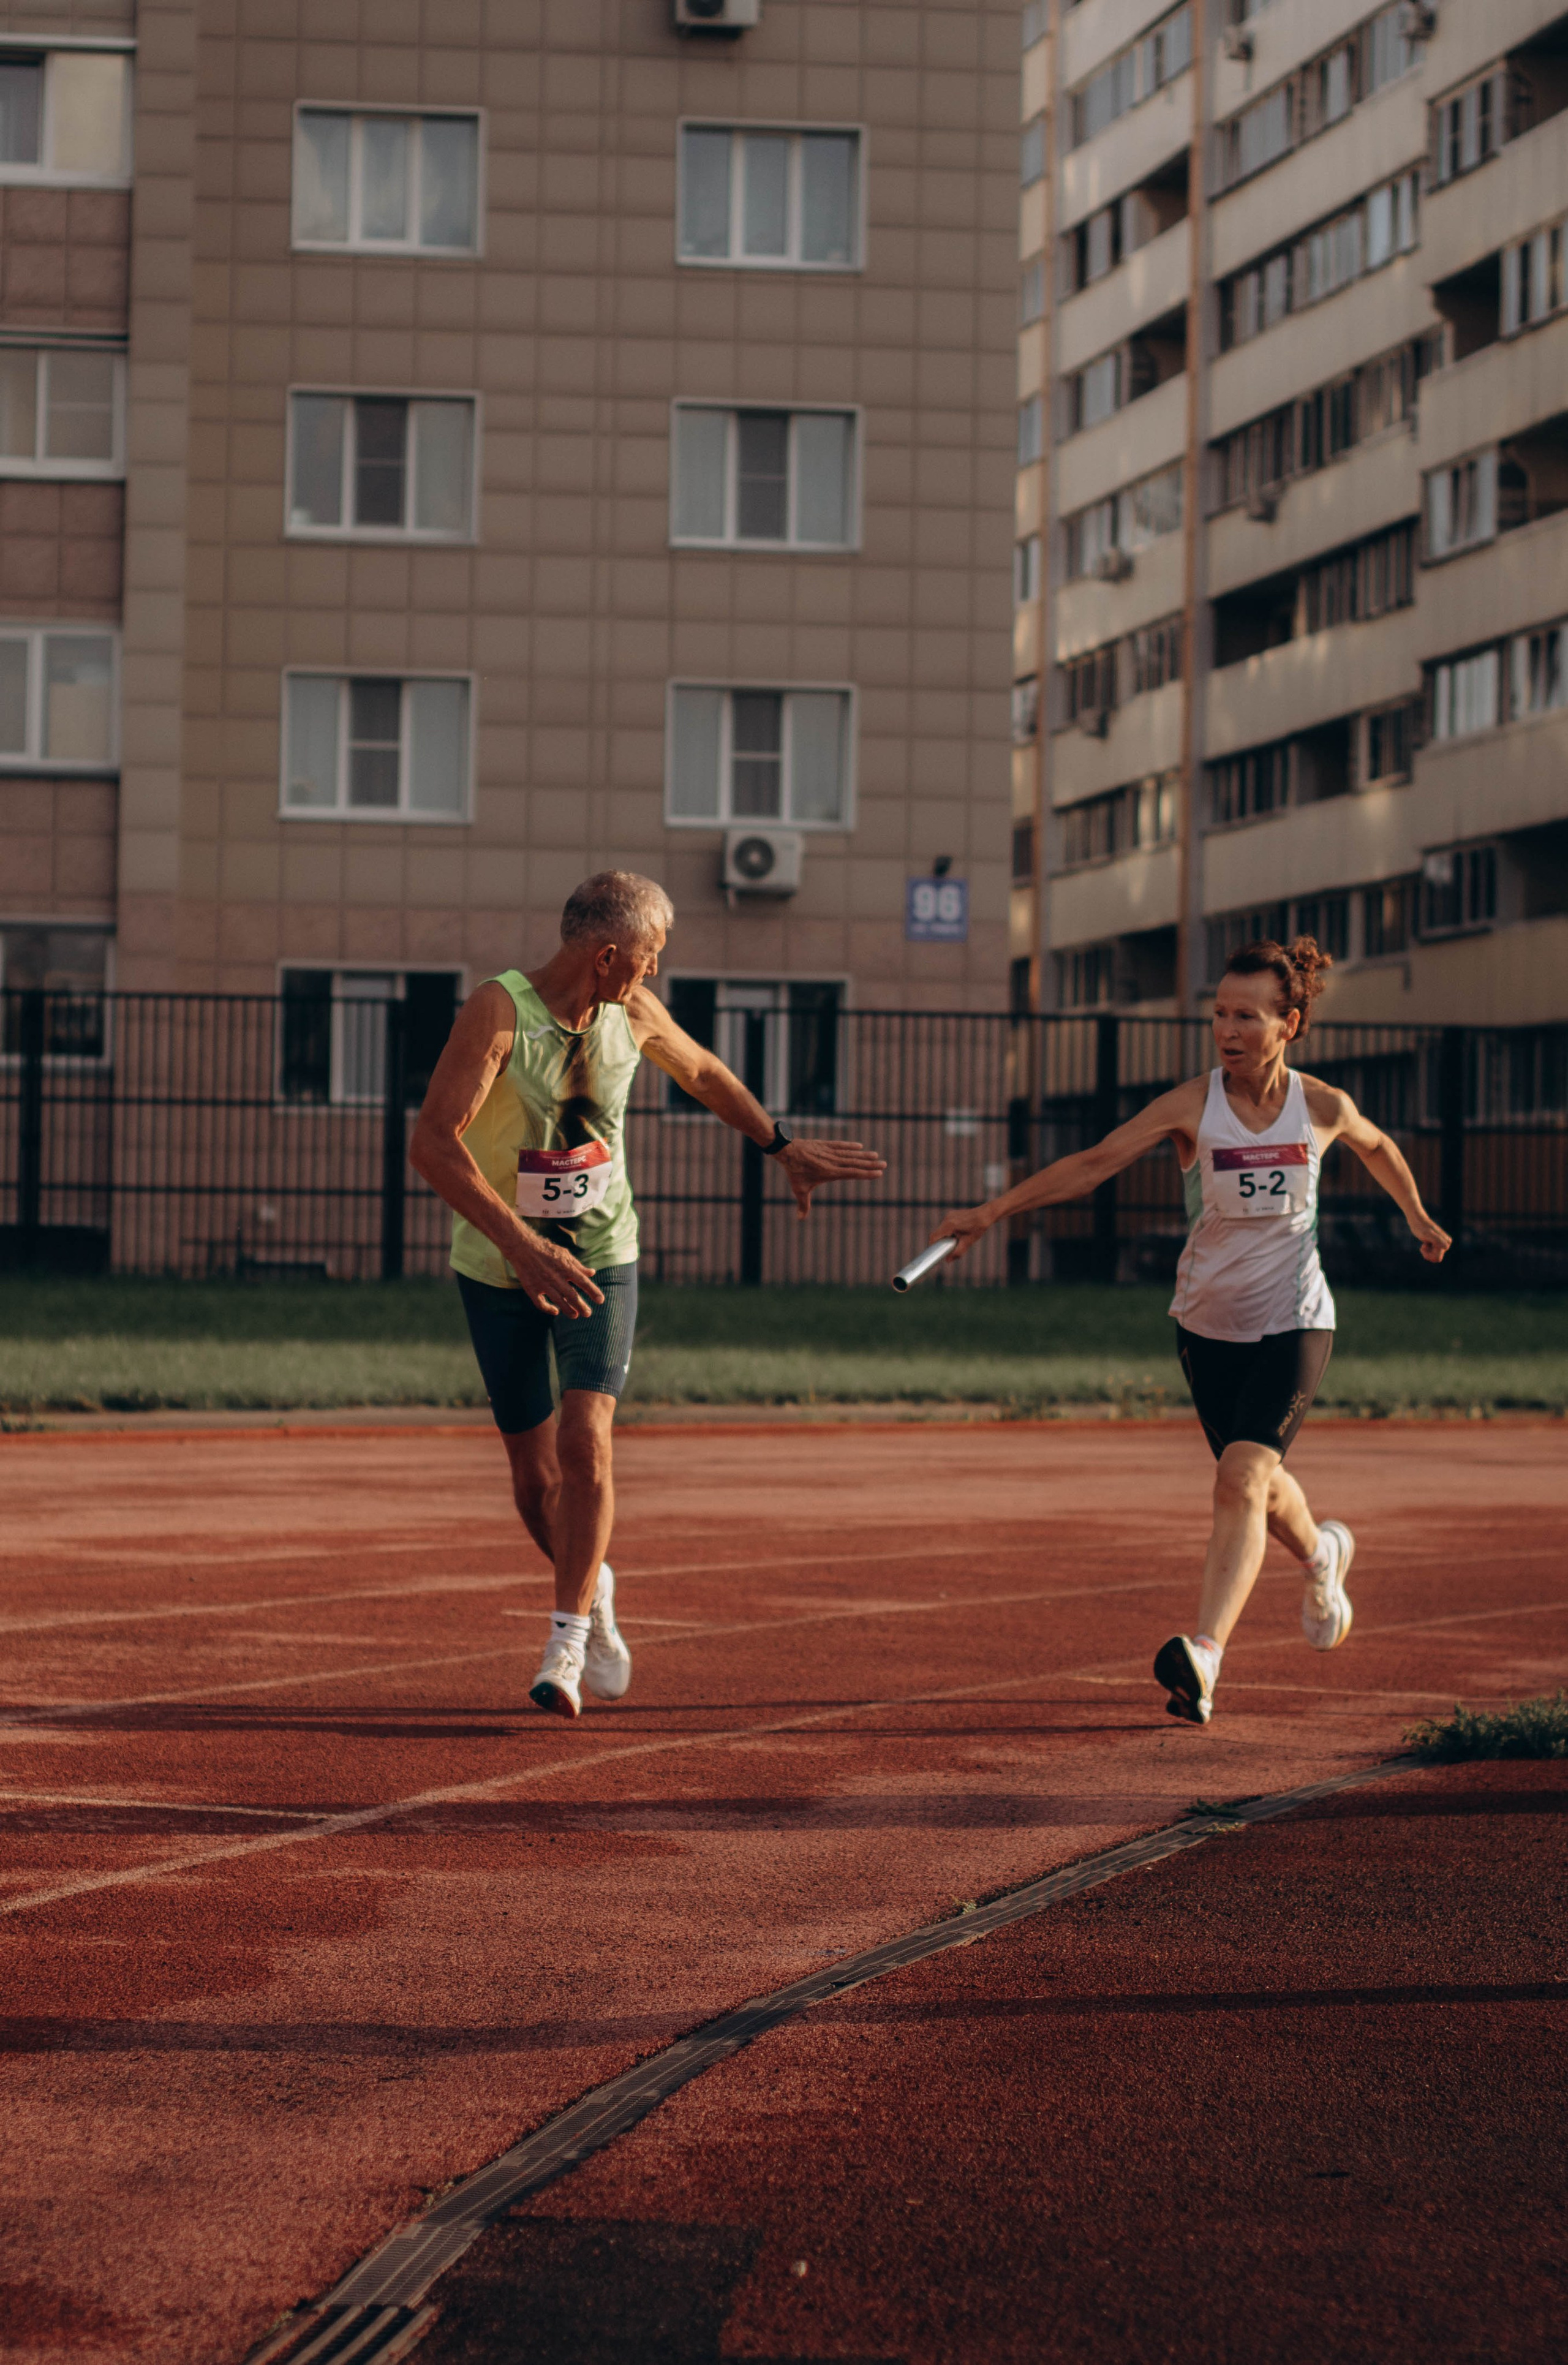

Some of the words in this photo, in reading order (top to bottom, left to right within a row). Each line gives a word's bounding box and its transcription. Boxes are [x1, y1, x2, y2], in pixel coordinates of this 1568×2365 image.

[914, 885, 961, 920] 96
[552, 1155, 586, 1166] МАСТЕРС
[1242, 1152, 1280, 1161] МАСТЕРС
[542, 1174, 589, 1201] 5-3
[1239, 1171, 1286, 1198] 5-2
